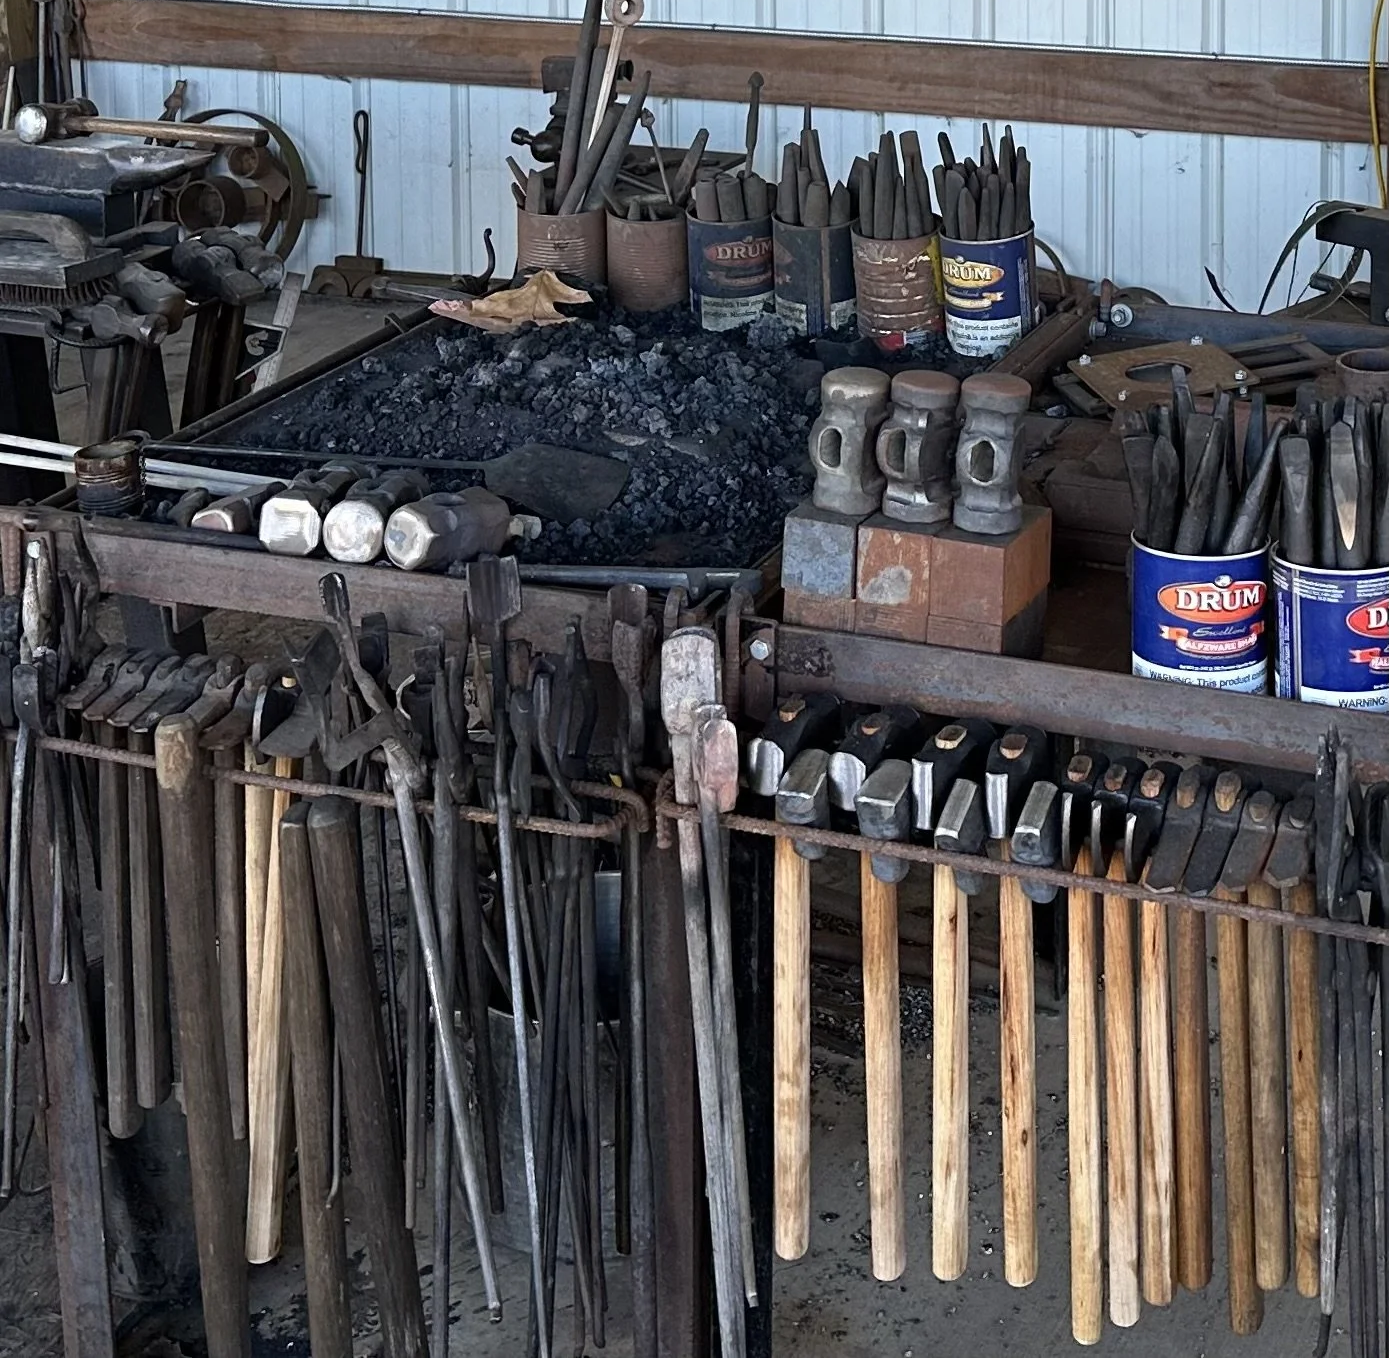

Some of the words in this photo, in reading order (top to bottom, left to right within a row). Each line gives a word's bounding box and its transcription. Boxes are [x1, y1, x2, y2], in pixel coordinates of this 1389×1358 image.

[717, 240, 772, 260] DRUM
[1176, 585, 1260, 612] DRUM
[1219, 673, 1251, 689] product
